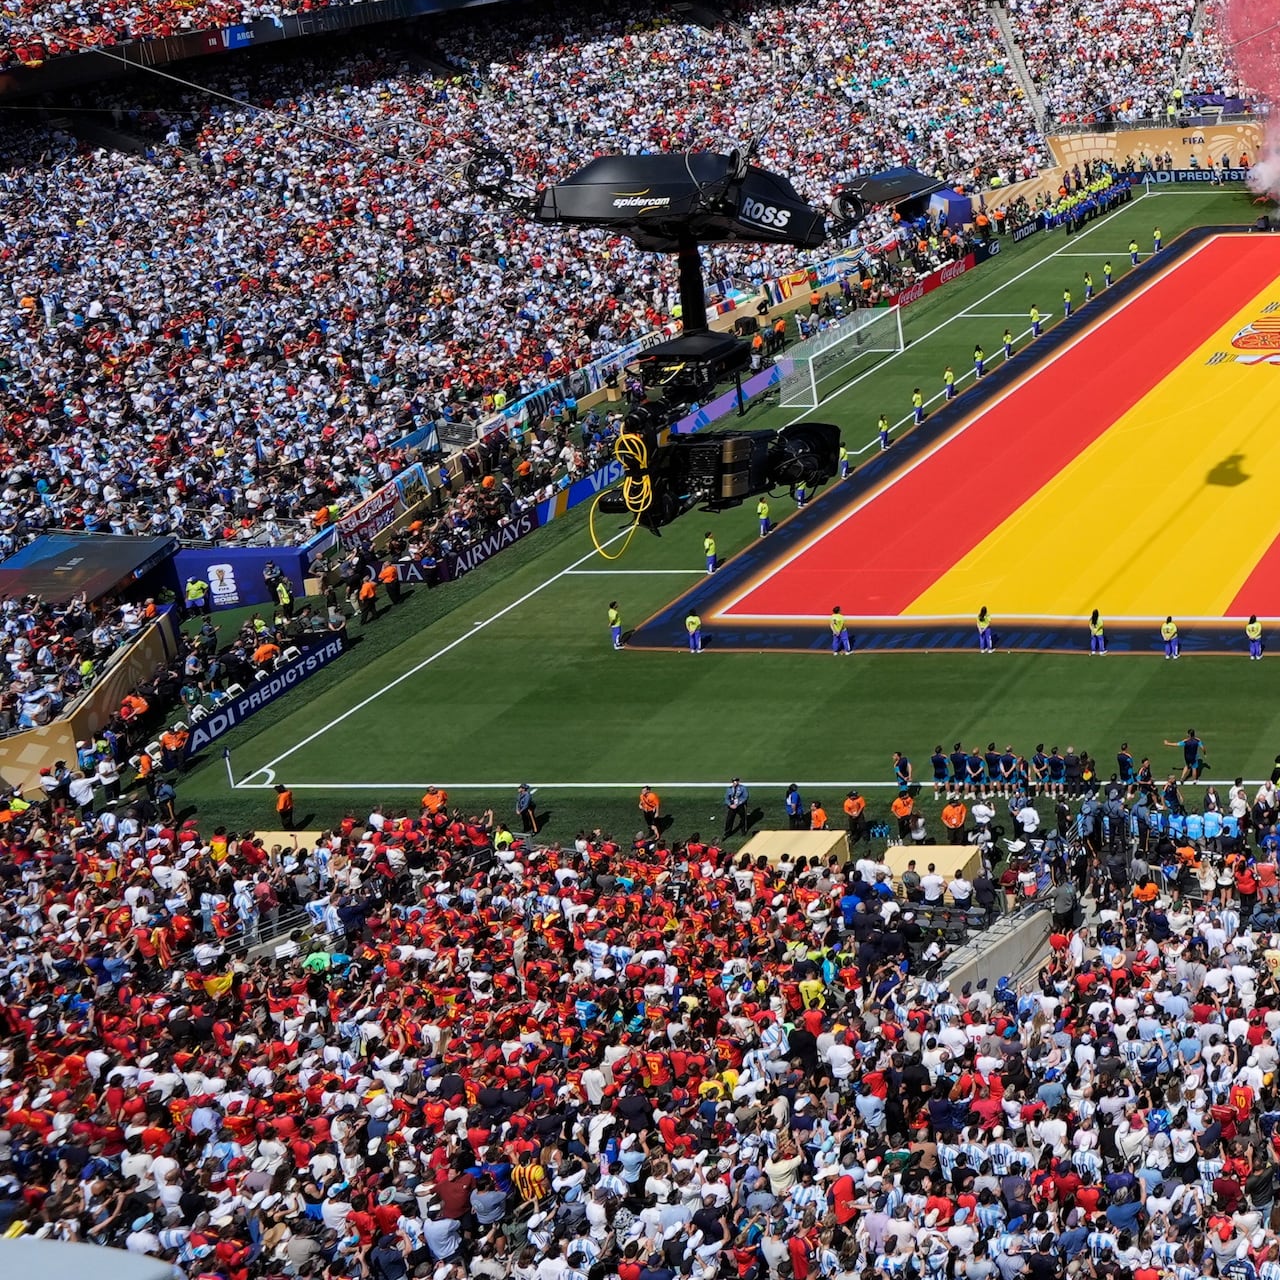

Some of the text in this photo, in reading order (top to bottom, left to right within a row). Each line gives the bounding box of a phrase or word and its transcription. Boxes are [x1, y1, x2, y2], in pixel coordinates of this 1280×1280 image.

[221, 29, 230, 47] V
[1182, 137, 1205, 146] FIFA
[1141, 171, 1176, 185] ADI
[612, 197, 672, 208] spidercam
[742, 197, 792, 227] ROSS
[587, 459, 626, 492] VIS
[455, 514, 533, 578] AIRWAYS
[190, 707, 237, 752] ADI
[1236, 1094, 1247, 1109] 10
